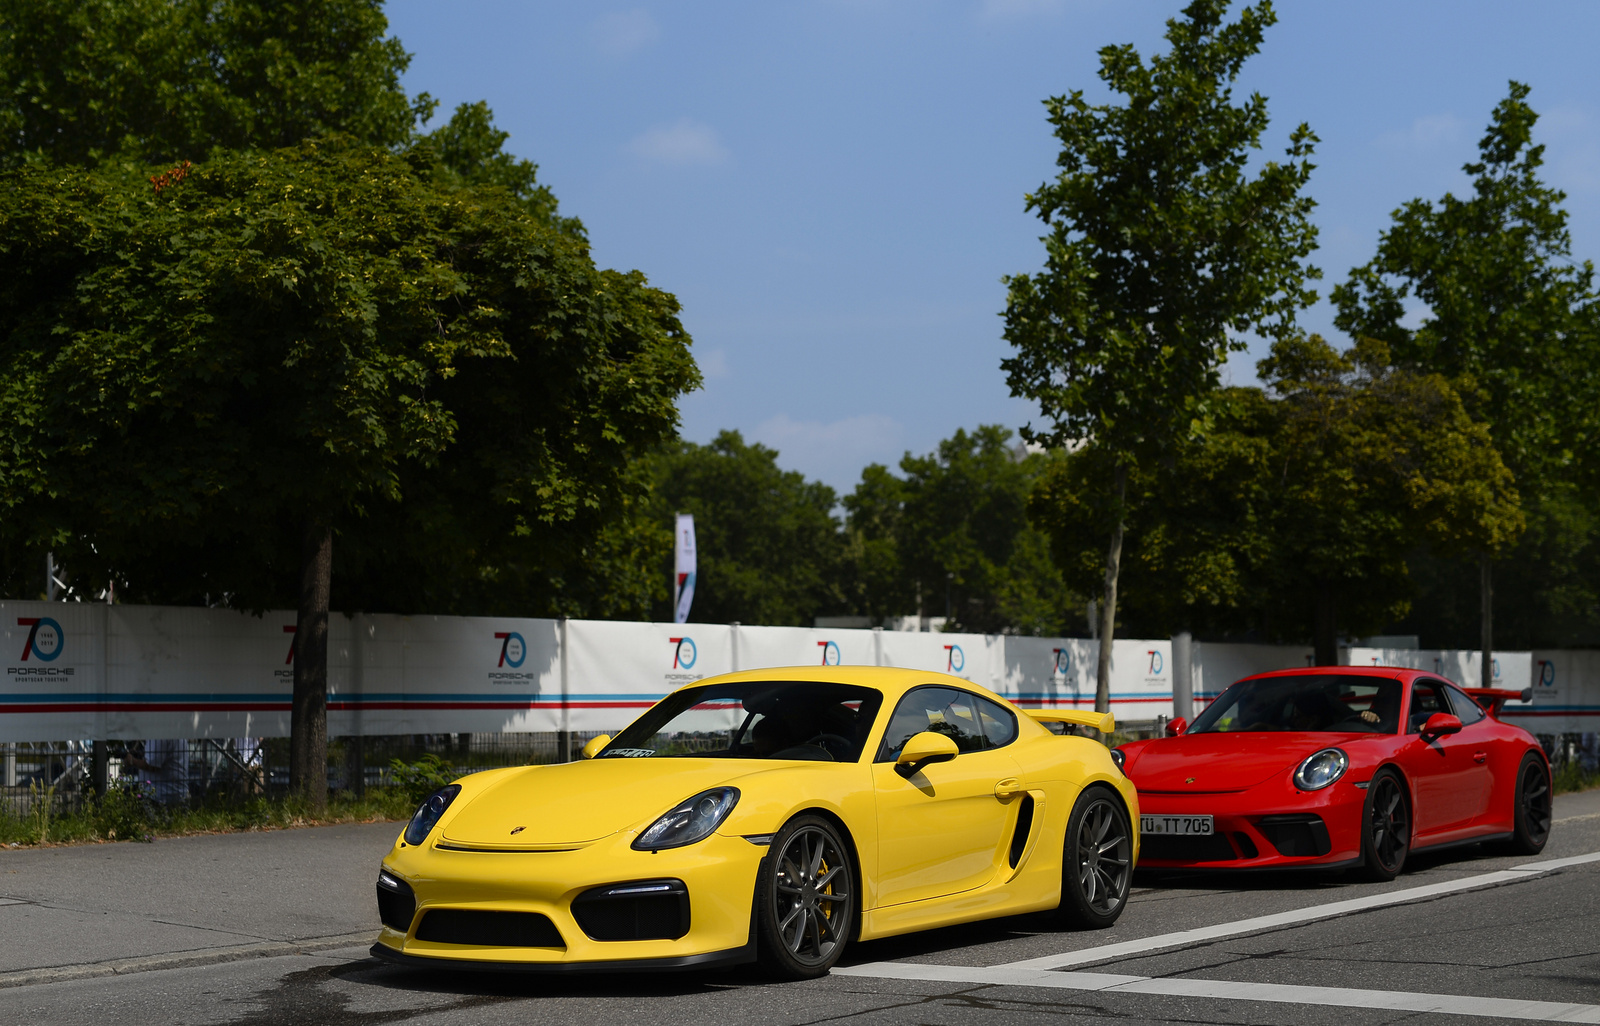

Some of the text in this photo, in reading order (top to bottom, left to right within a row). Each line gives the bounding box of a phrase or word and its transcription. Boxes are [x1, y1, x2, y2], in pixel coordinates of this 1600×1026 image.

[17, 616, 64, 662] 70
[283, 625, 297, 665] 7
[494, 632, 527, 668] 70
[669, 637, 697, 670] 70
[817, 641, 841, 666] 70
[944, 645, 965, 672] 70
[1053, 648, 1070, 674] 70
[1147, 651, 1163, 674] 70
[1538, 660, 1555, 687] 70
[1163, 818, 1180, 832] TT
[1184, 819, 1210, 833] 705
